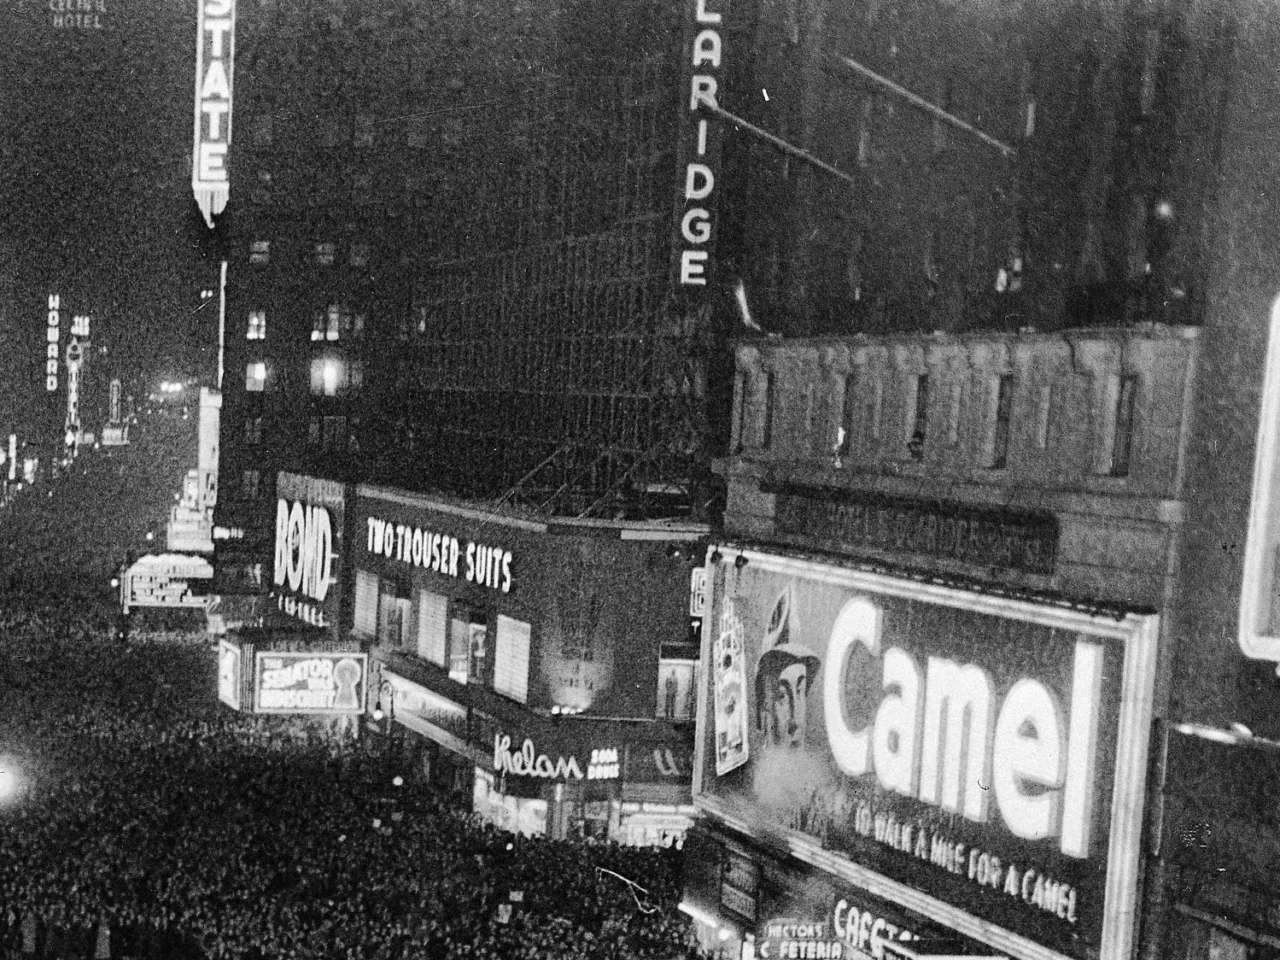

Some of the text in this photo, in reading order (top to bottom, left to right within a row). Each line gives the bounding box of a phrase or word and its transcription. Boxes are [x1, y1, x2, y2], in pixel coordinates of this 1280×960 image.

[47, 294, 59, 391] HOWARD
[274, 499, 332, 601] BOND
[396, 525, 459, 577] TROUSER
[466, 541, 513, 593] SUITS
[823, 596, 1104, 860] Camel
[874, 811, 912, 853] WALK
[914, 827, 928, 860] A
[930, 832, 966, 875] MILE
[968, 848, 1002, 889] FOR
[1004, 864, 1020, 896] A
[1021, 867, 1078, 923] CAMEL
[760, 940, 843, 960] CFETERIA
